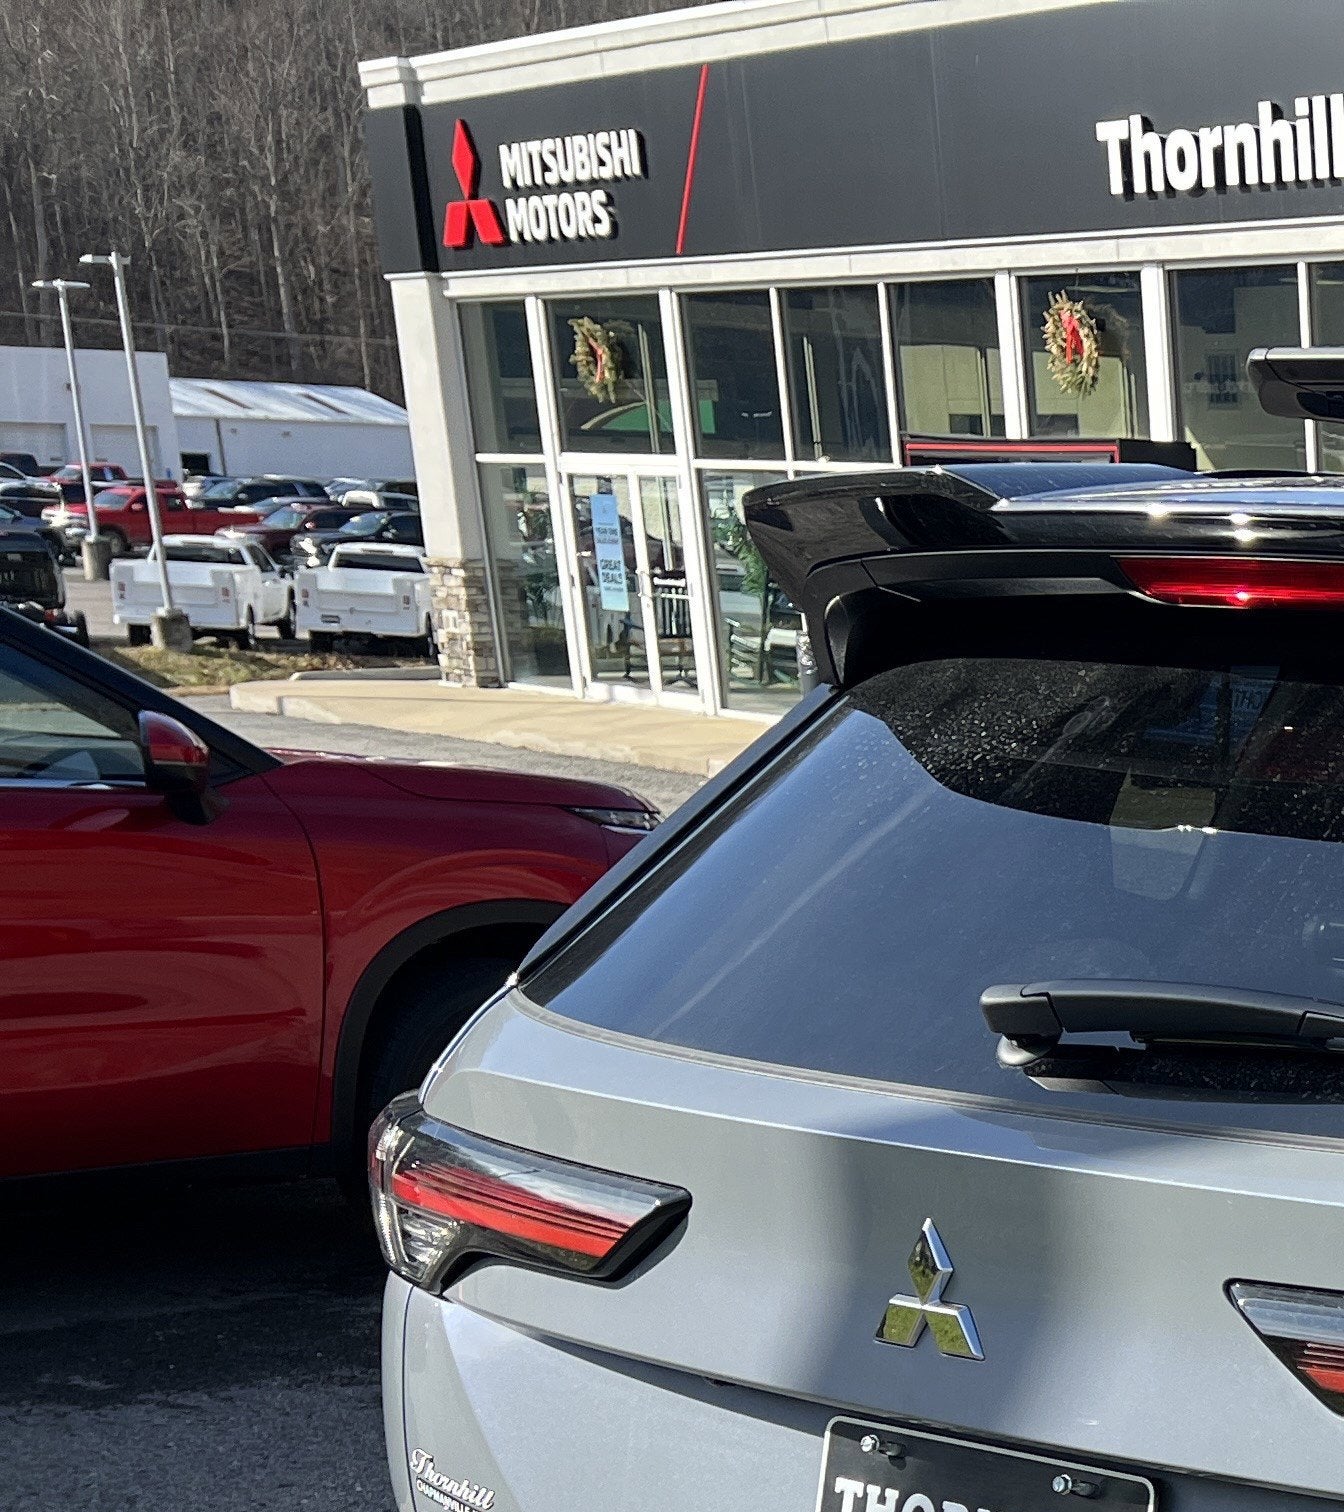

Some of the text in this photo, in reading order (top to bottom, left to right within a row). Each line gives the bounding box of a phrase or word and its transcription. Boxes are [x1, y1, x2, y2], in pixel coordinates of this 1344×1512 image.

[499, 128, 643, 189] MITSUBISHI
[505, 189, 611, 244] MOTORS
[410, 1448, 495, 1511] Thornhill
